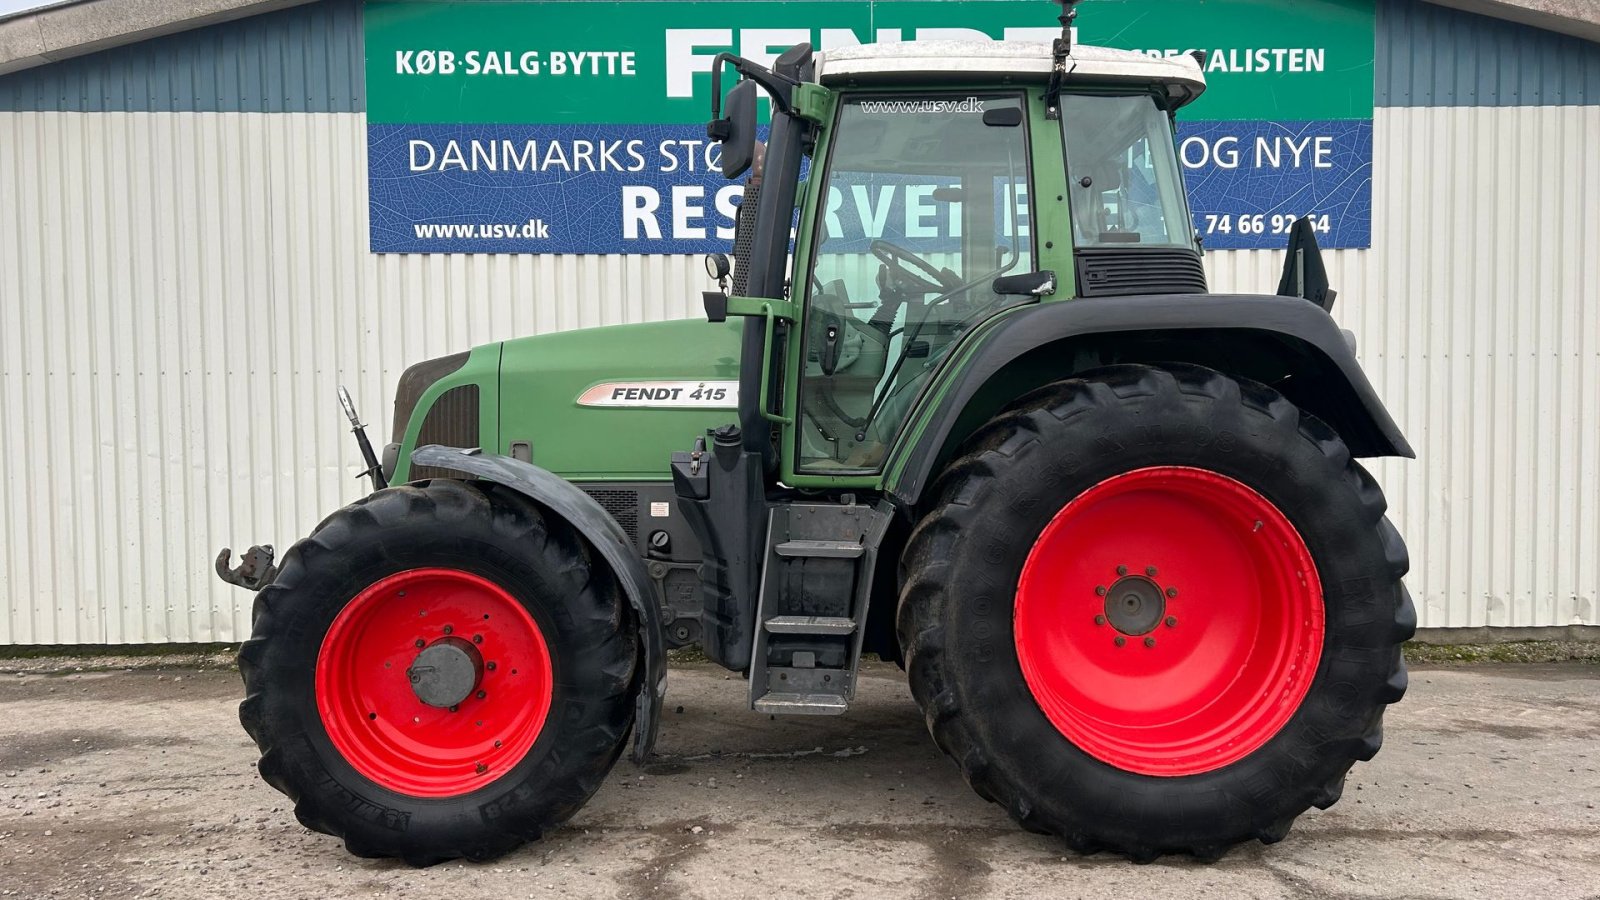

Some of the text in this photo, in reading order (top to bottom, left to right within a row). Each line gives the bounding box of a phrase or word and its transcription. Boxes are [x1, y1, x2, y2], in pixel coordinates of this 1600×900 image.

[861, 97, 984, 114] www.usv.dk
[409, 139, 645, 171] DANMARKS
[1180, 136, 1239, 169] OG
[1256, 136, 1333, 168] NYE
[414, 219, 549, 239] www.usv.dk
[1205, 214, 1232, 234] 74
[1238, 214, 1265, 234] 66
[1271, 214, 1298, 234] 92
[611, 388, 727, 401] FENDT 415
